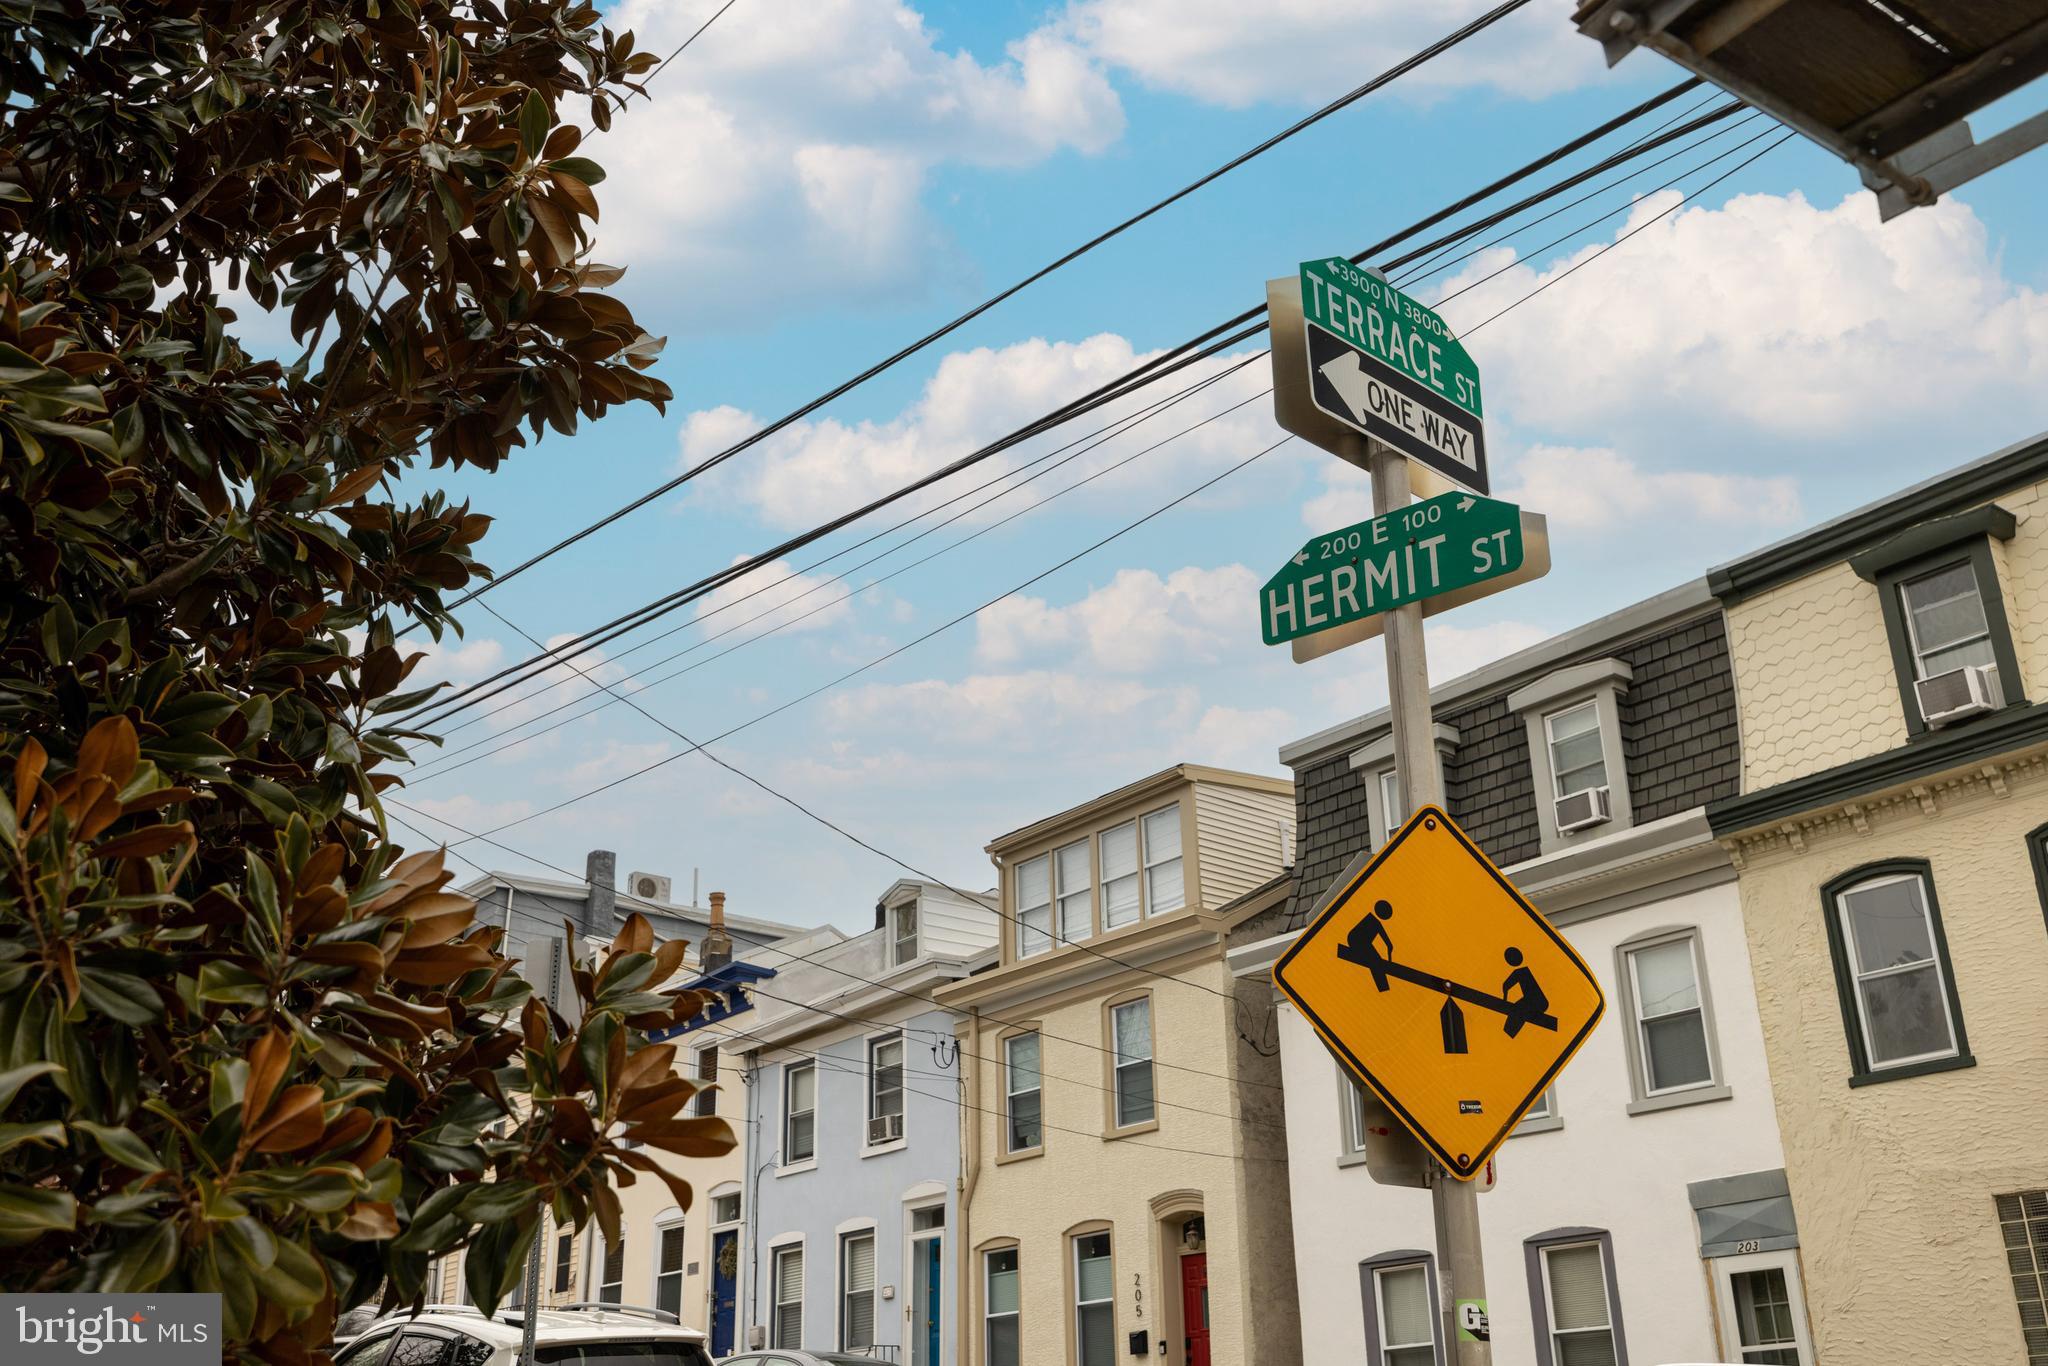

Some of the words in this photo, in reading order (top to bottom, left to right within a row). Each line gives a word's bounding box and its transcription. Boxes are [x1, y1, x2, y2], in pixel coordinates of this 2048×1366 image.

[1340, 264, 1380, 300] 3900
[1384, 286, 1399, 315] N
[1404, 302, 1442, 336] 3800
[1306, 270, 1444, 390] TERRACE
[1455, 372, 1476, 409] ST
[1367, 380, 1416, 433] ONE
[1422, 410, 1468, 461] WAY
[1320, 532, 1361, 560] 200
[1372, 517, 1389, 545] E
[1402, 504, 1442, 532] 100
[1268, 533, 1446, 638] HERMIT
[1471, 529, 1511, 574] ST
[1737, 1241, 1759, 1253] 203
[1133, 1272, 1143, 1318] 205
[1459, 1302, 1481, 1330] G
